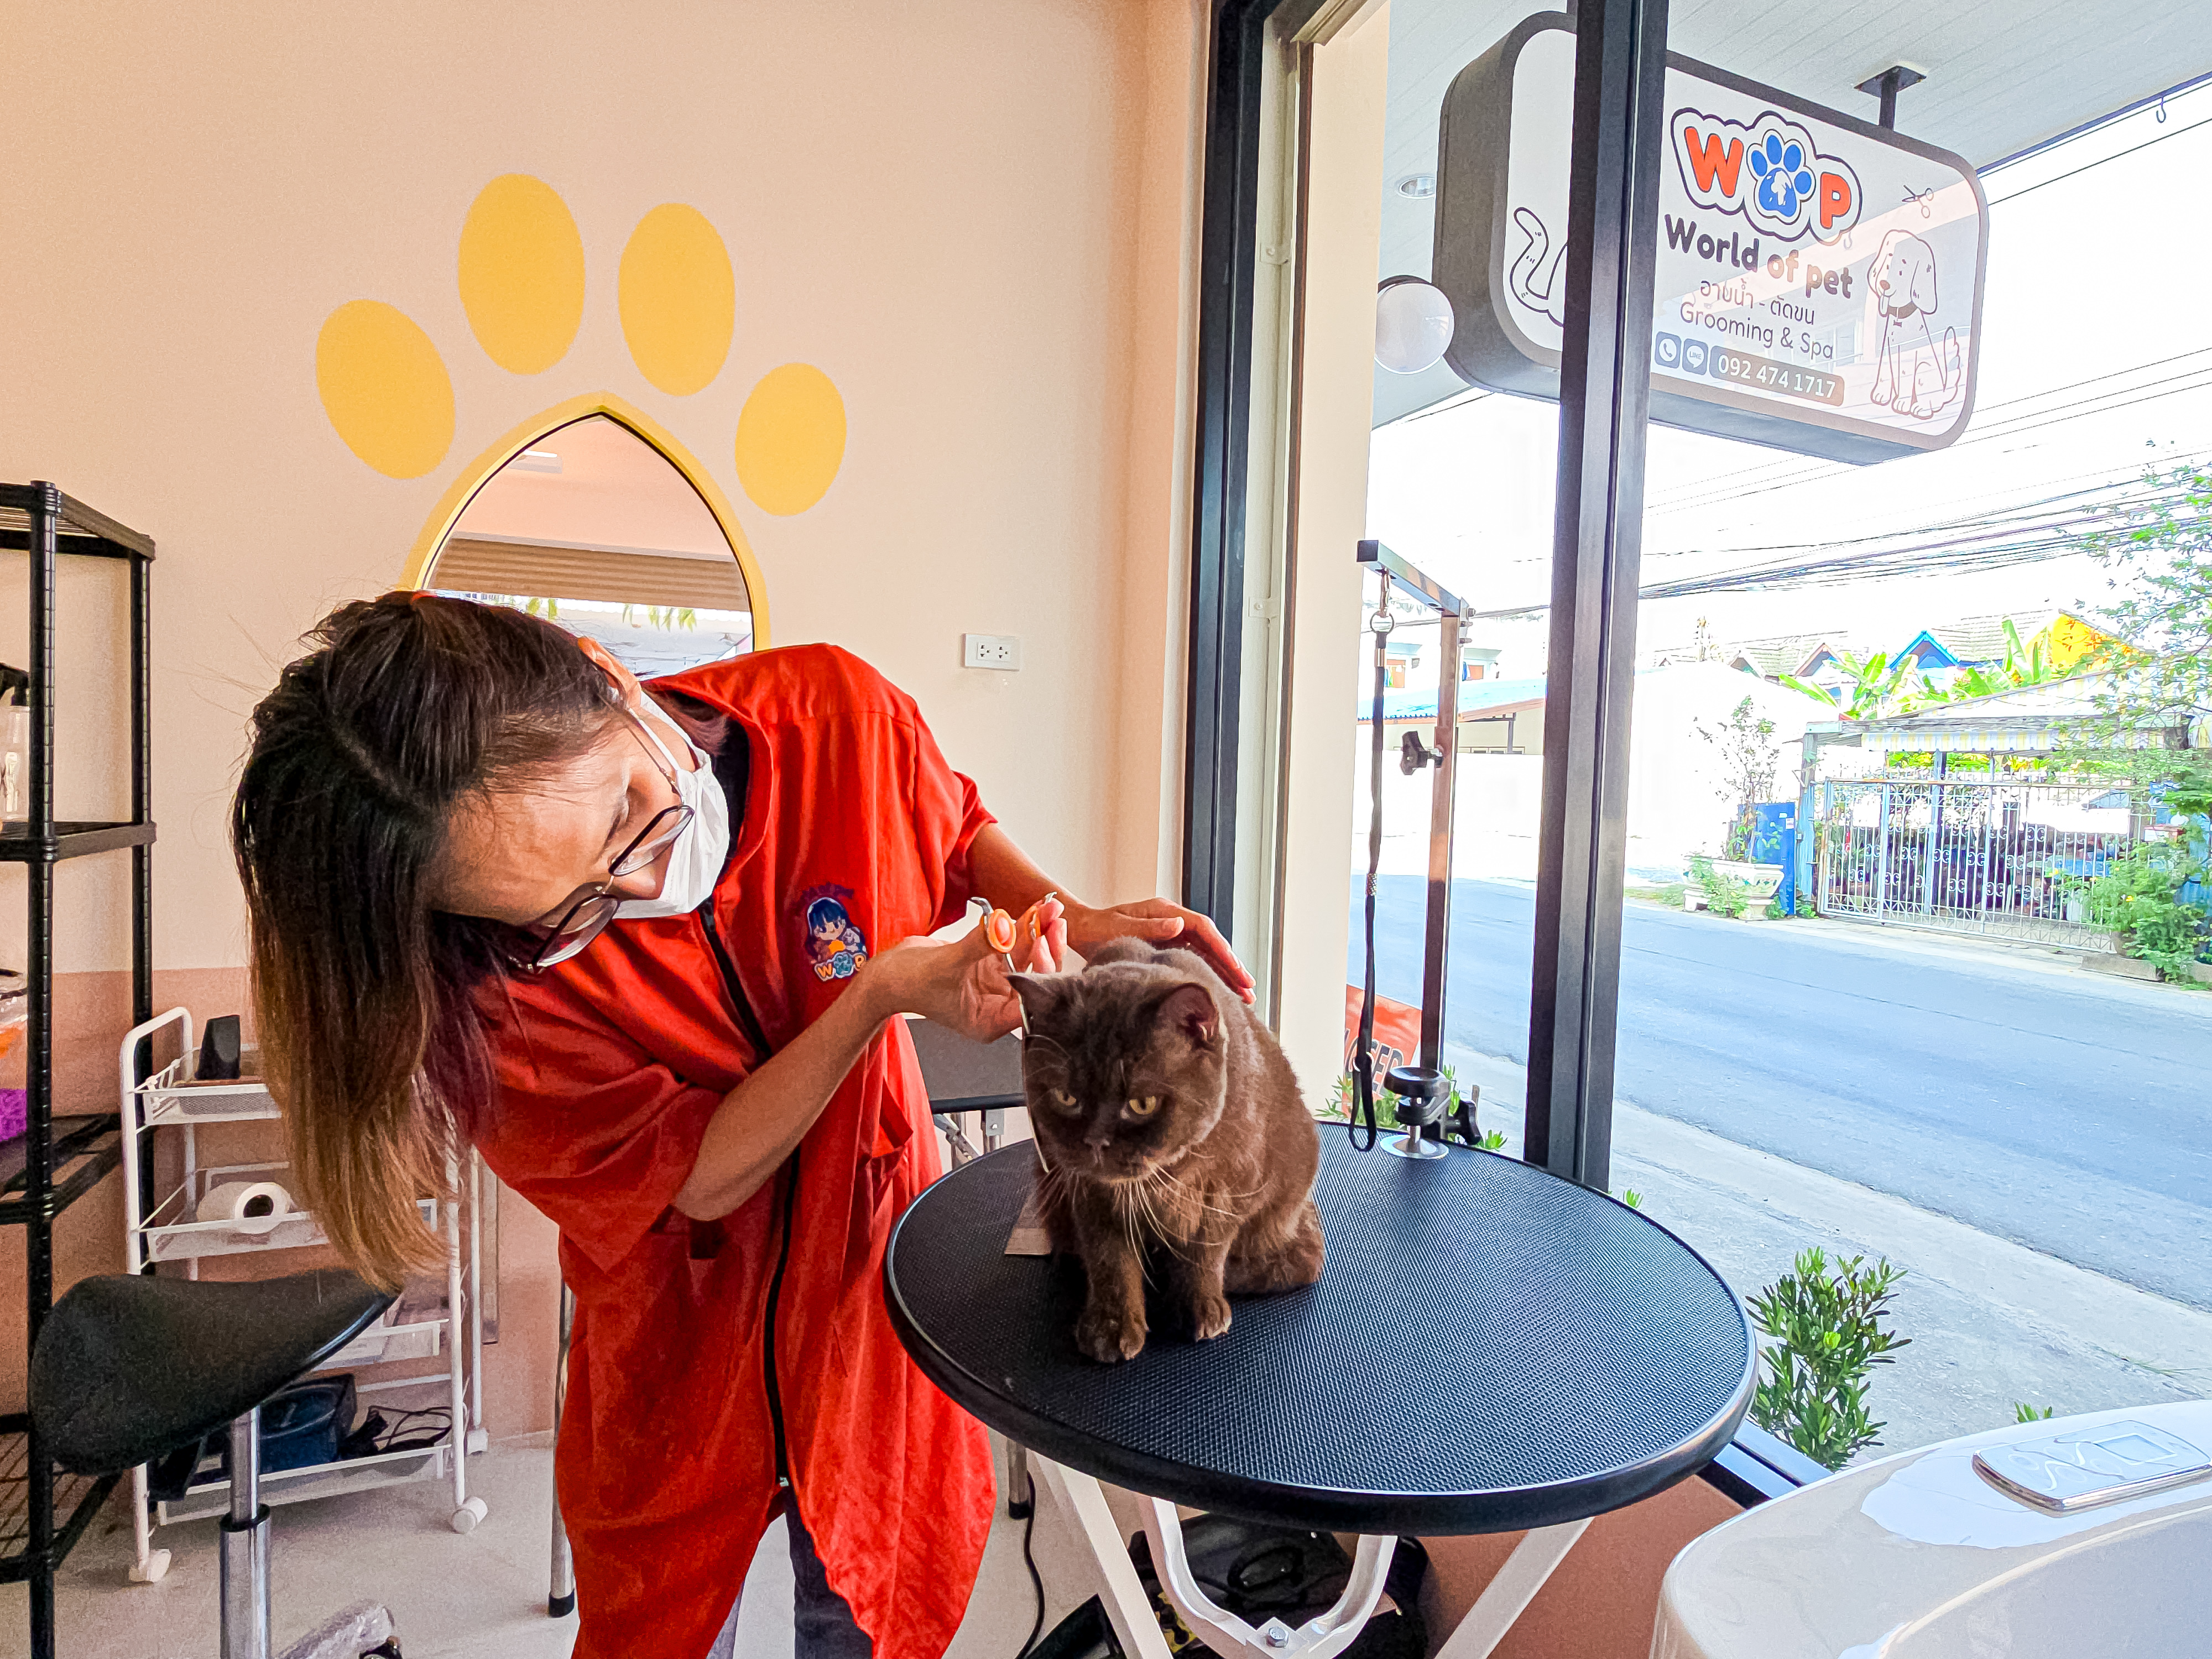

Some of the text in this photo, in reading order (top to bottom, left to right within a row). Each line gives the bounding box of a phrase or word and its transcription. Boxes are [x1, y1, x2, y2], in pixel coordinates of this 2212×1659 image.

[1664, 214, 1853, 299] World of pet
[1700, 278, 1754, 309] อาบน้ำ
[1770, 295, 1814, 325] ตัดขน
[1680, 301, 1833, 360] Grooming & Spa
[1718, 354, 1836, 399] 092 474 1717
